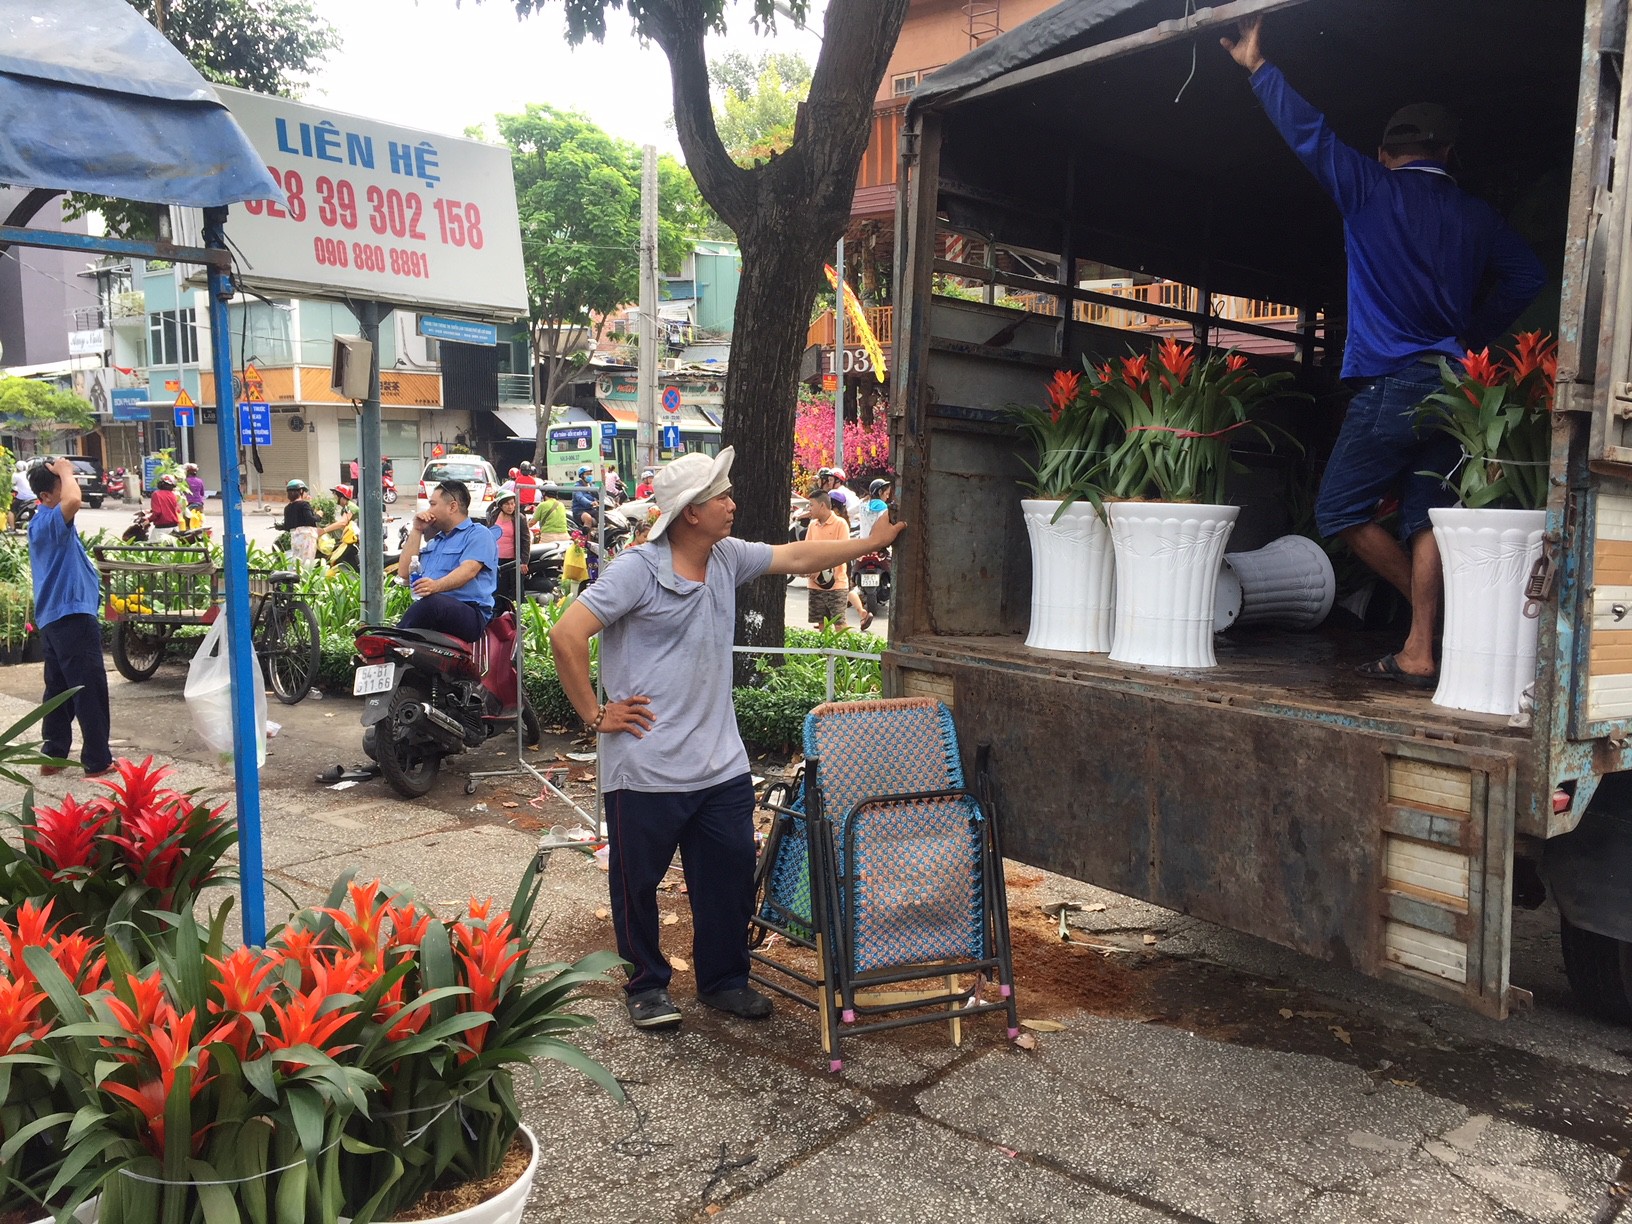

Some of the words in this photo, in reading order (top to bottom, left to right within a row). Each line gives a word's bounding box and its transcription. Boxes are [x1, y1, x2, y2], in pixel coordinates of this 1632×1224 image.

[275, 118, 375, 170] LIÊN
[388, 141, 441, 189] HỆ
[245, 166, 306, 223] 28
[316, 176, 358, 230] 39
[367, 185, 427, 241] 302
[433, 197, 484, 250] 158
[314, 236, 349, 269] 090
[353, 242, 386, 273] 880
[390, 247, 430, 279] 8891
[579, 439, 586, 447] 02
